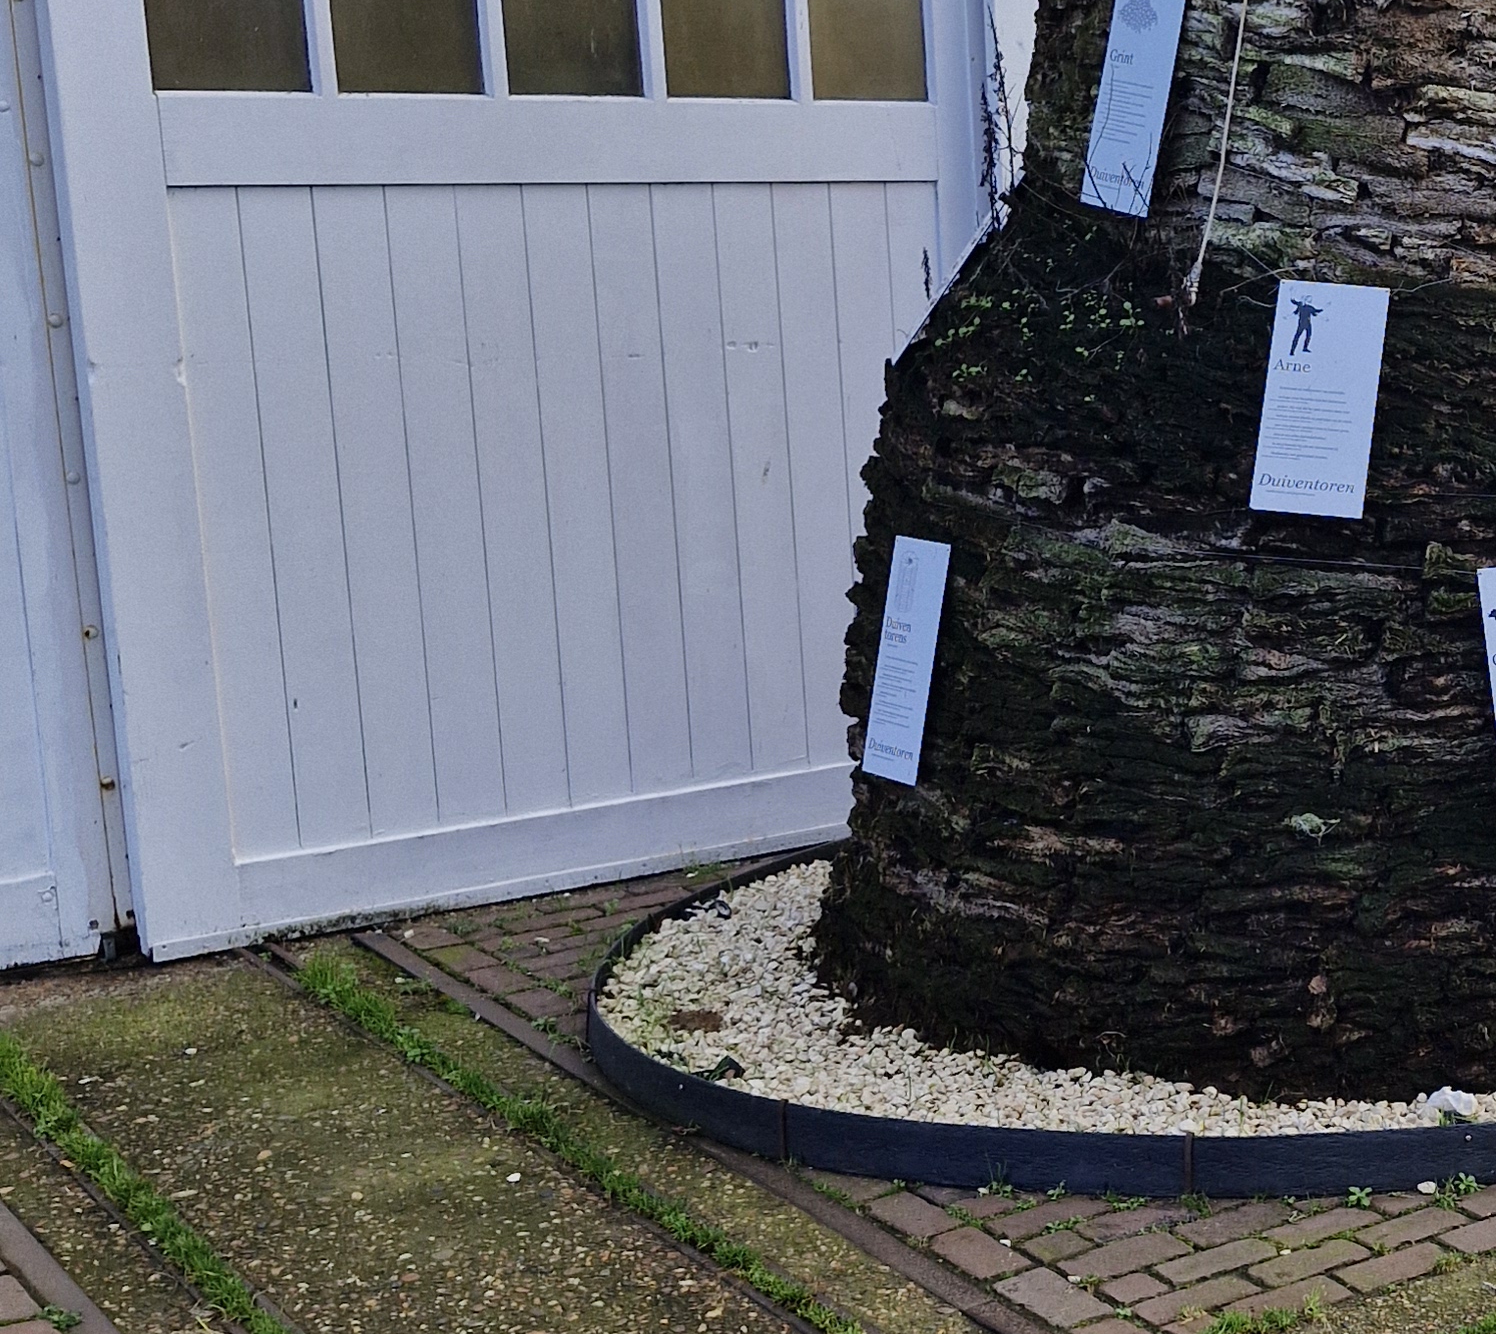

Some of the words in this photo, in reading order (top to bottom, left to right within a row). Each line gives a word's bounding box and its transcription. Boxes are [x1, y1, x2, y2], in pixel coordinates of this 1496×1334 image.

[1110, 48, 1134, 65] Grint
[1273, 357, 1312, 374] Arne
[1257, 472, 1356, 494] Duiventoren
[885, 615, 912, 634] Duiven
[868, 737, 914, 761] Duiventoren
